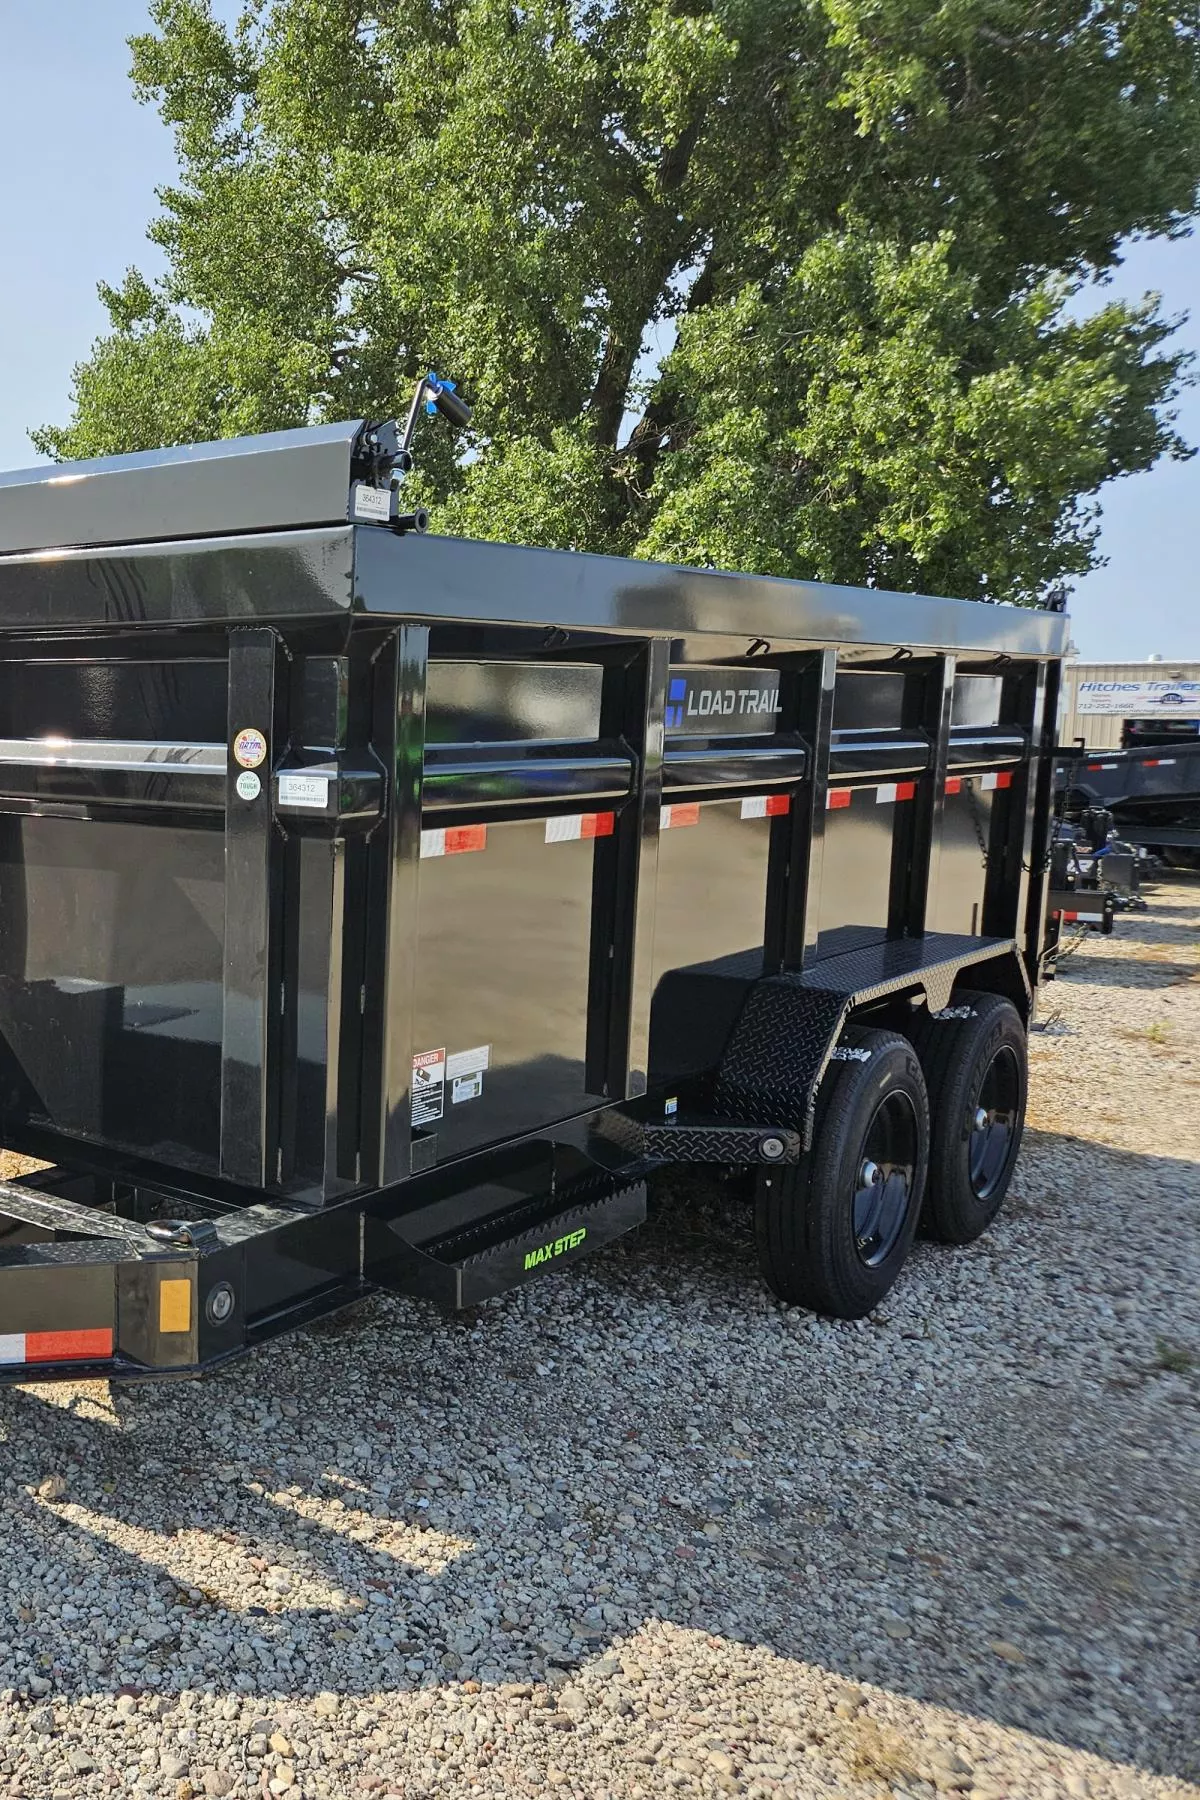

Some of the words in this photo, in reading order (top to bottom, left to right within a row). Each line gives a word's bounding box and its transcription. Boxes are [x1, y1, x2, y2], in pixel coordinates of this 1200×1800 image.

[362, 493, 382, 504] 364312
[1080, 682, 1140, 692] Hitches
[687, 690, 736, 716] LOAD
[738, 689, 783, 714] TRAIL
[288, 783, 316, 792] 364312
[524, 1242, 554, 1271] MAX
[554, 1227, 586, 1256] STEP
